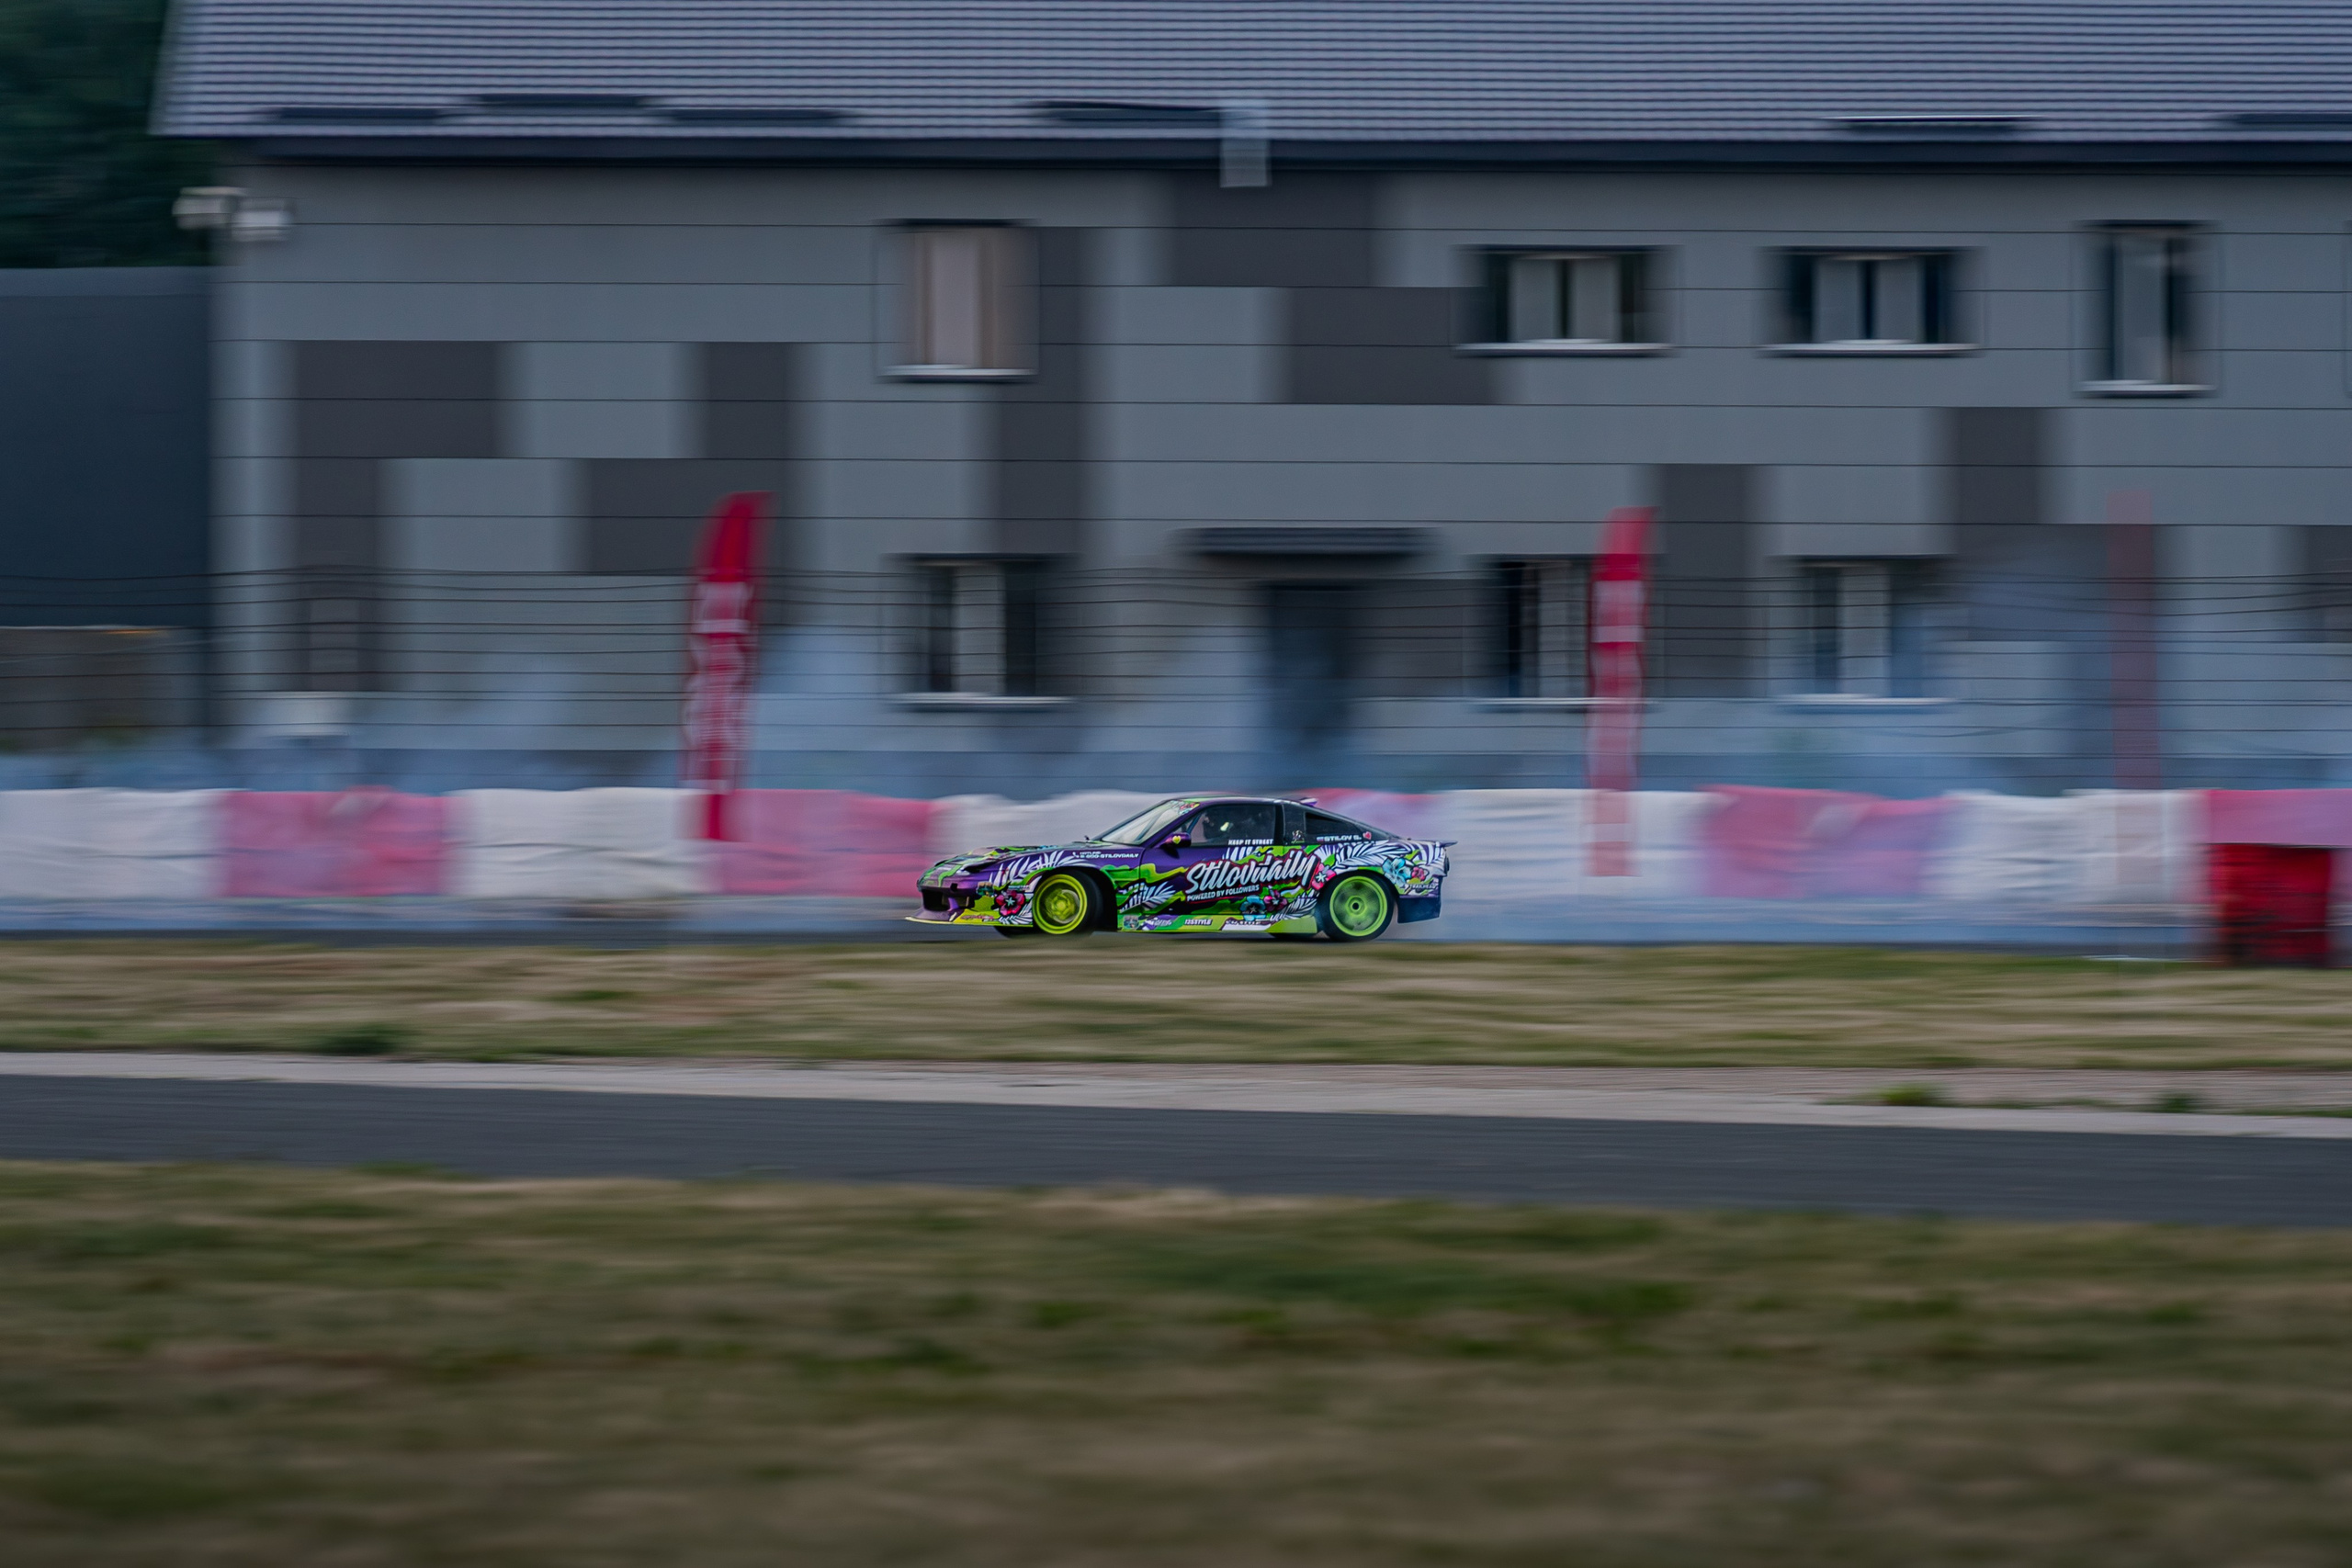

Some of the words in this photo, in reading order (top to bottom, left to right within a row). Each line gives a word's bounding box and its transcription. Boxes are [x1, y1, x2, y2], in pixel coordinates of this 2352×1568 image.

[1324, 834, 1351, 842] STILOV
[1186, 891, 1216, 902] POWERED
[1216, 889, 1225, 897] BY
[1225, 884, 1261, 896] FOLLOWERS
